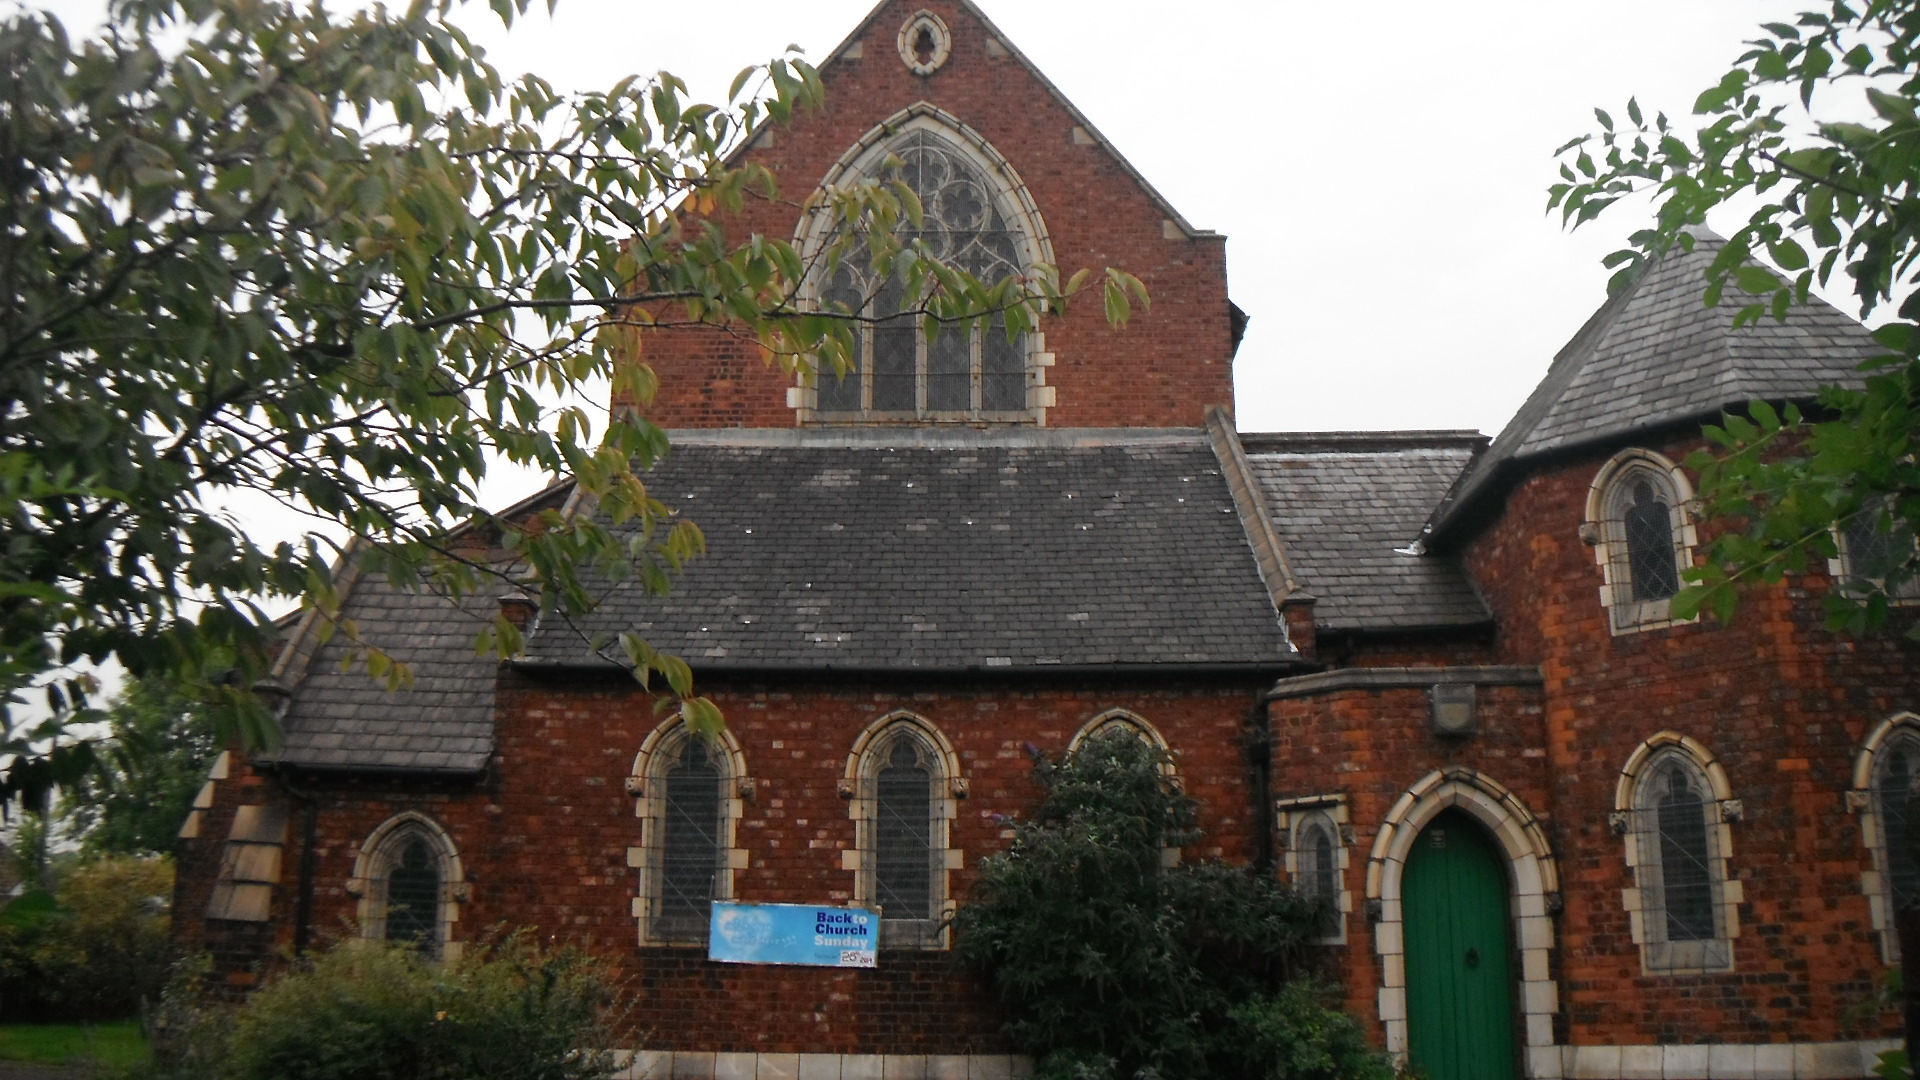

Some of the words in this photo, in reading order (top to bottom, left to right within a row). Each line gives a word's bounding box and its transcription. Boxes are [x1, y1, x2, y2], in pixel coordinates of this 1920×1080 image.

[816, 912, 852, 923] Back
[853, 914, 868, 924] to
[815, 923, 867, 935] Church
[814, 935, 868, 950] Sunday
